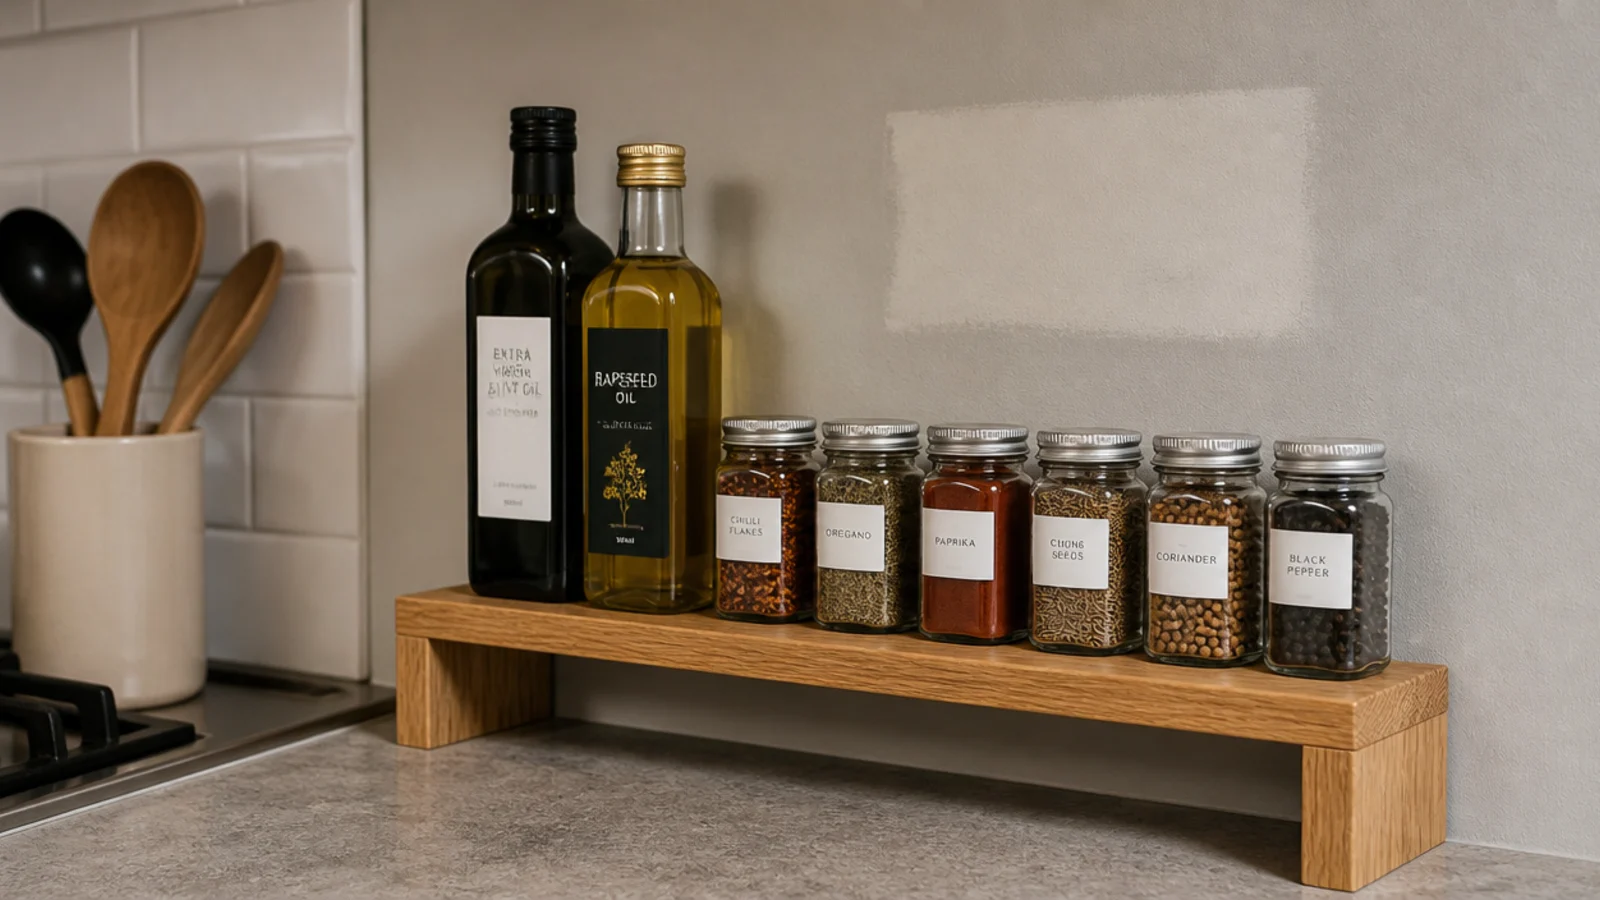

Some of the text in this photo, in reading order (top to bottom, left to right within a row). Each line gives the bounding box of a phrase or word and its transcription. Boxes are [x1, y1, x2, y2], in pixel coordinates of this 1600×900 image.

[615, 391, 637, 404] OIL
[826, 528, 872, 540] OREGANO
[935, 536, 976, 547] PAPRIKA
[1156, 552, 1217, 564] CORIANDER
[1289, 554, 1326, 564] BLACK
[1287, 566, 1329, 577] PEPPER
